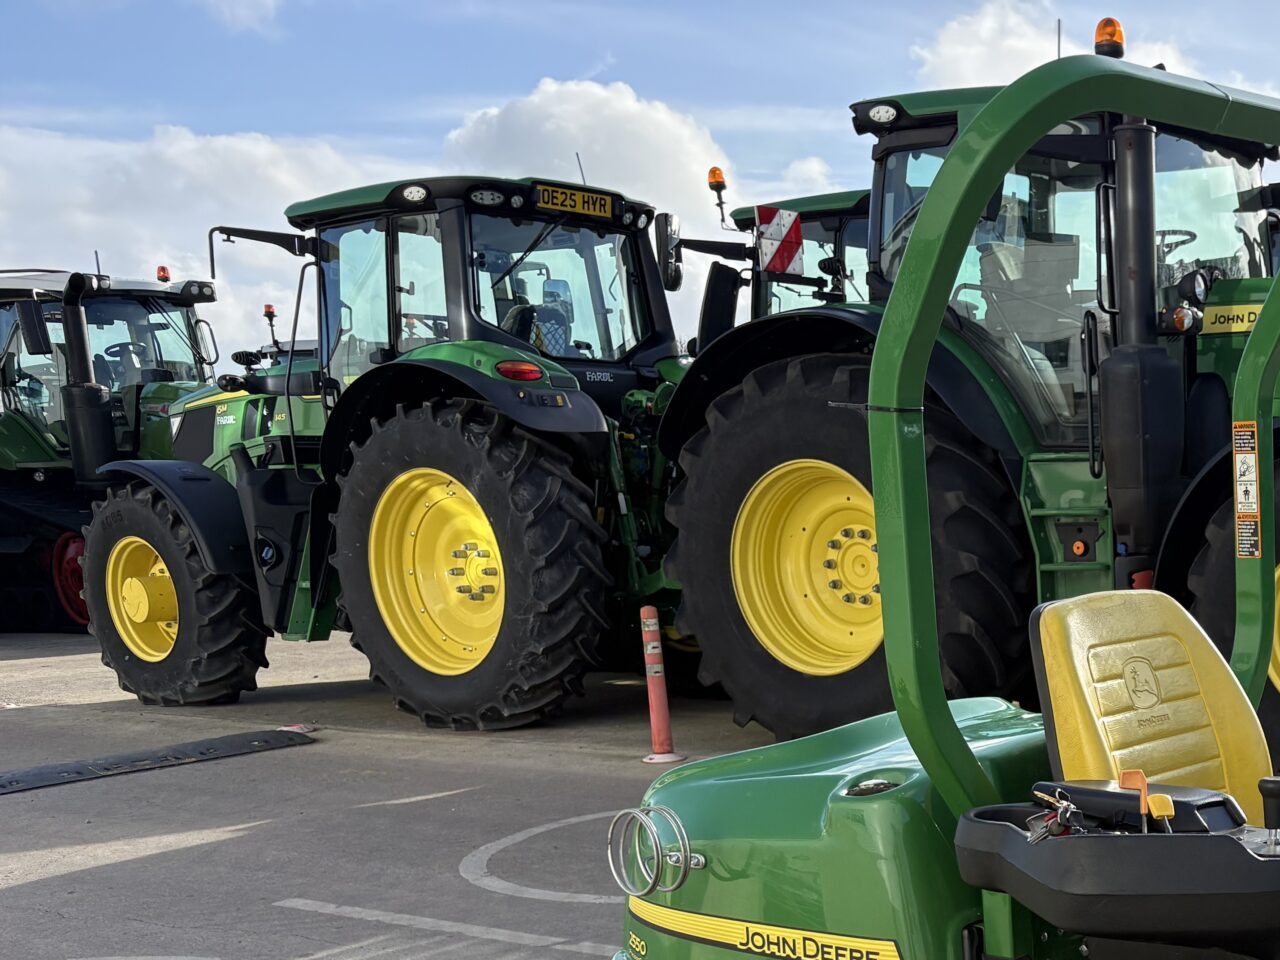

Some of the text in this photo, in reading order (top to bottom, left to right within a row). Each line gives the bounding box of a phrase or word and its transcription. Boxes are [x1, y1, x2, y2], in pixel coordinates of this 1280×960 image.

[542, 188, 607, 213] OE25 HYR
[1210, 313, 1244, 325] JOHN
[586, 371, 614, 382] FAROL
[739, 926, 797, 957] JOHN
